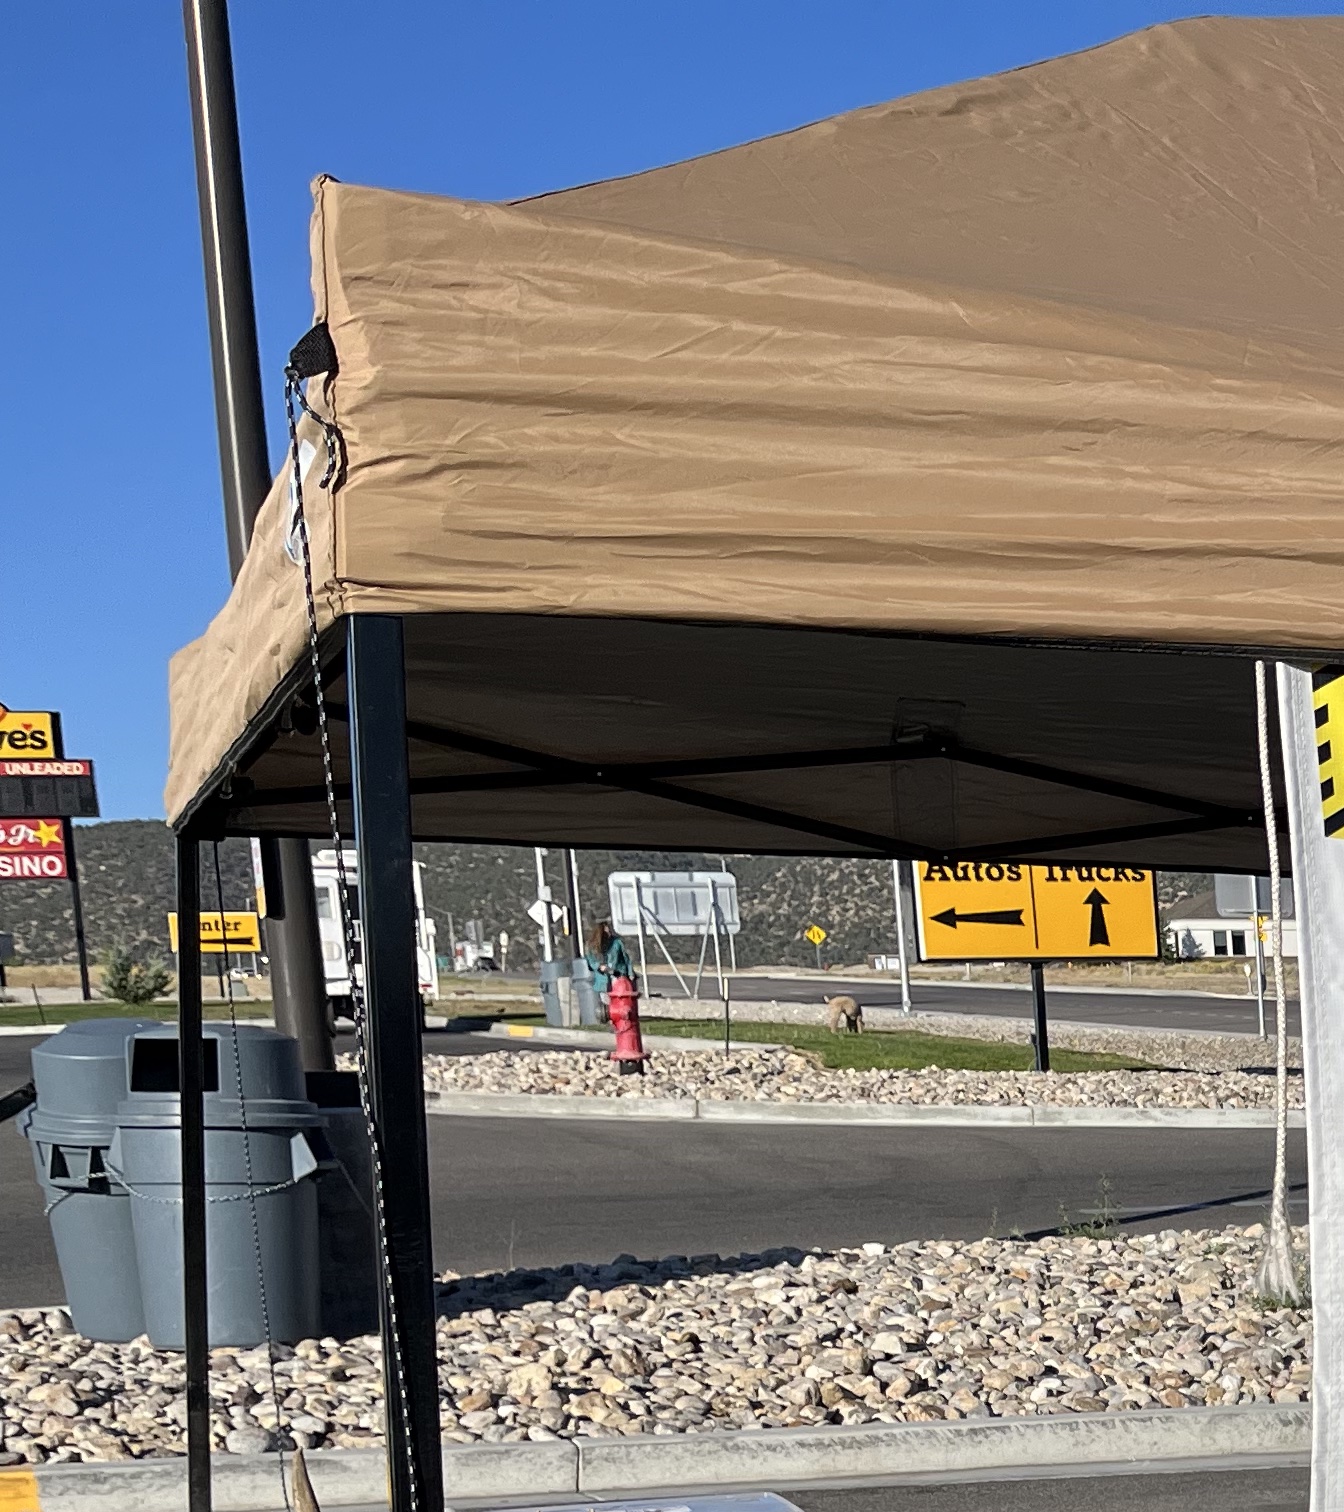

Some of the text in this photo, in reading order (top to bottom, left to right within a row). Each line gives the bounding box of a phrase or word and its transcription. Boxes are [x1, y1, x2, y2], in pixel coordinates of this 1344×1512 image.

[5, 762, 84, 776] UNLEADED
[0, 855, 63, 878] SINO
[200, 919, 242, 932] nter
